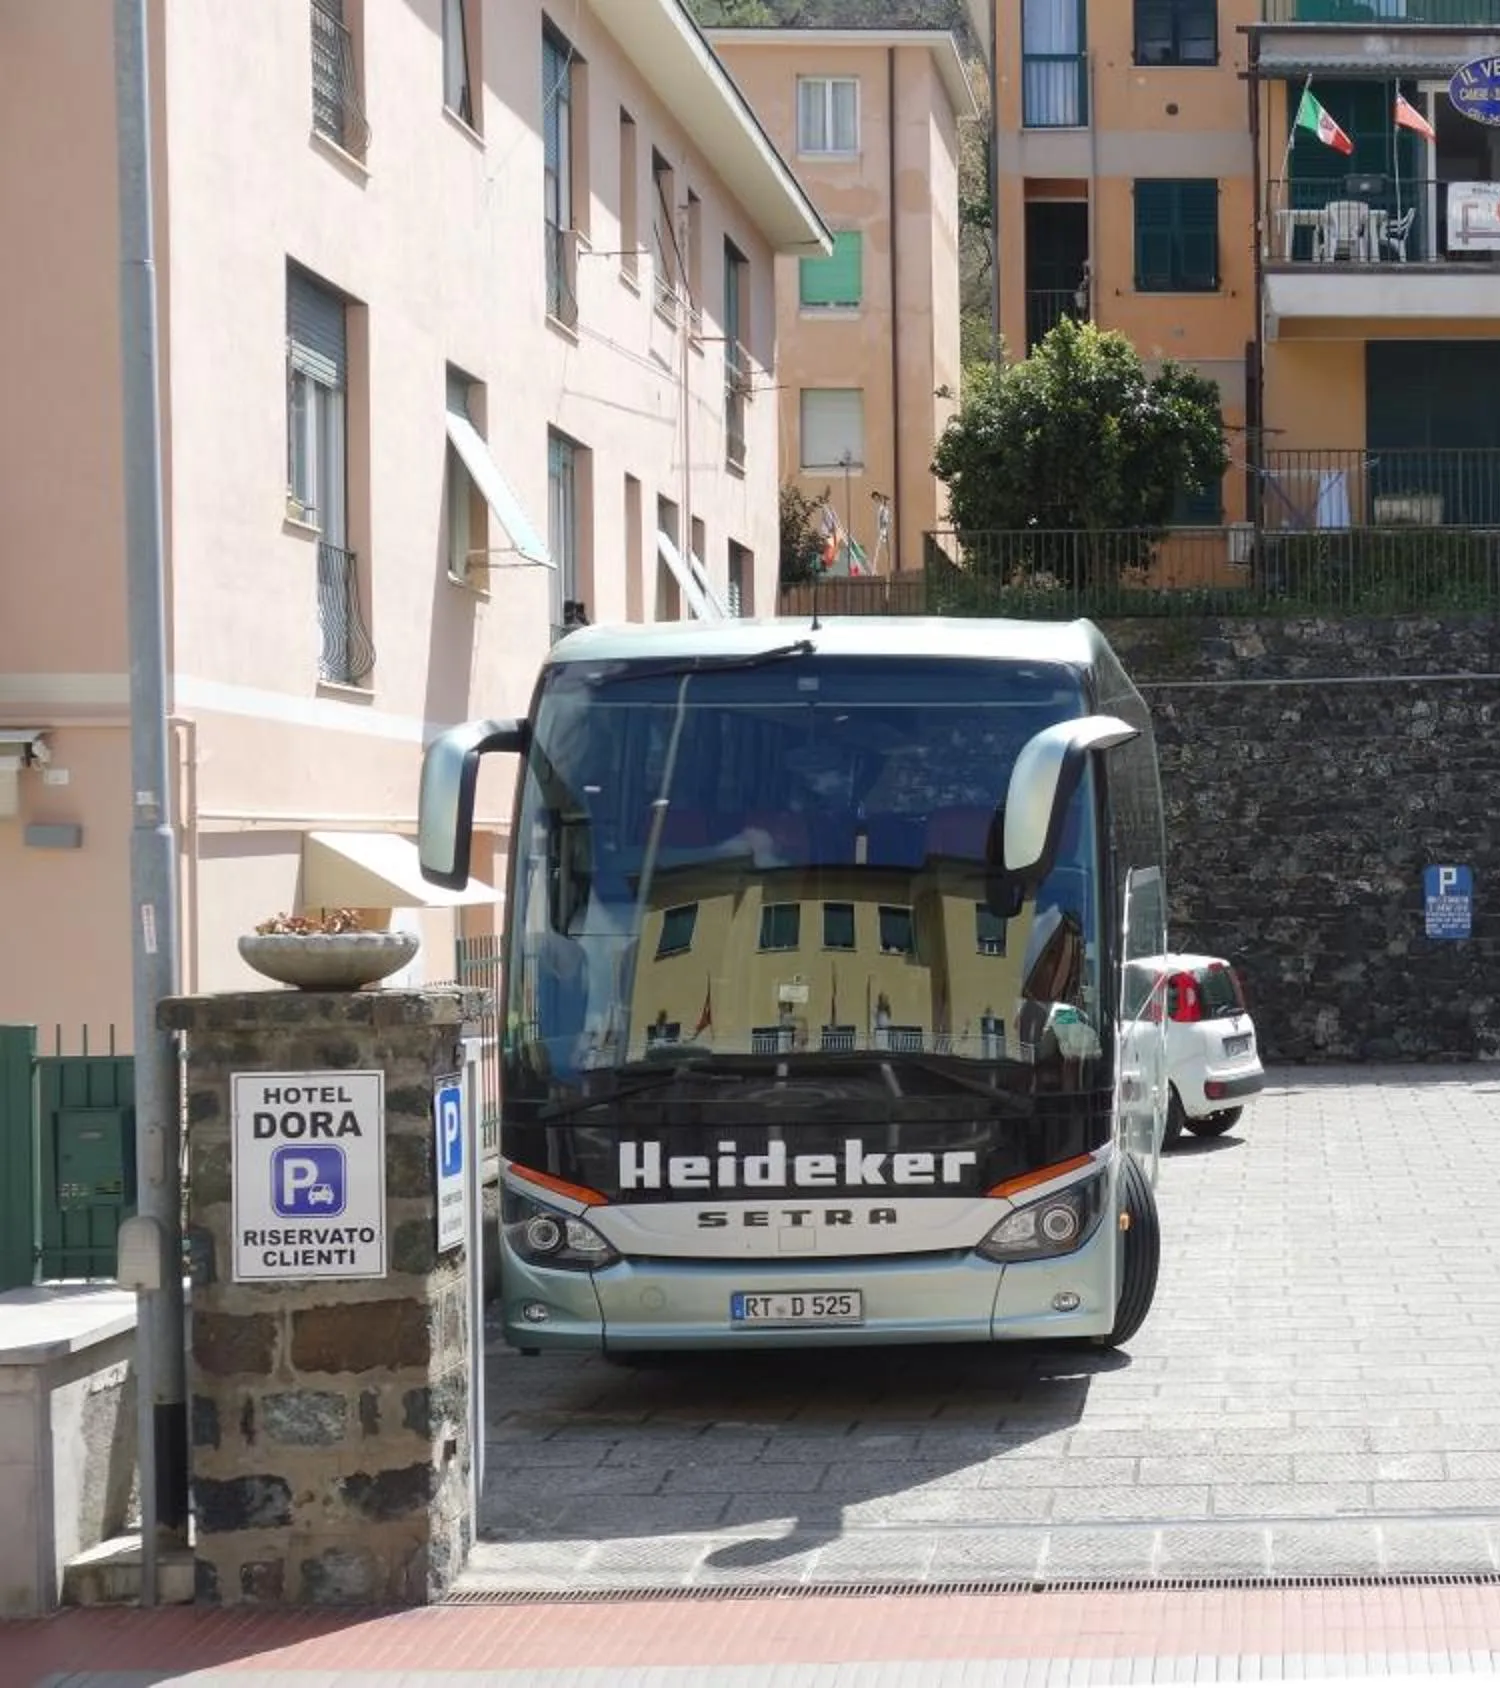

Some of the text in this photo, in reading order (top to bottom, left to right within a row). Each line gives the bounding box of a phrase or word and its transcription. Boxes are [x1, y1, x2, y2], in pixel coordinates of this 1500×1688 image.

[1461, 68, 1478, 86] IL
[1440, 867, 1457, 895] P
[263, 1086, 353, 1104] HOTEL
[253, 1111, 363, 1139] DORA
[443, 1101, 459, 1167] P
[619, 1139, 977, 1189] Heideker
[283, 1158, 319, 1206] P
[697, 1207, 898, 1228] SETRA
[243, 1227, 375, 1247] RISERVATO
[262, 1249, 356, 1267] CLIENTI
[745, 1295, 852, 1317] RT D 525
